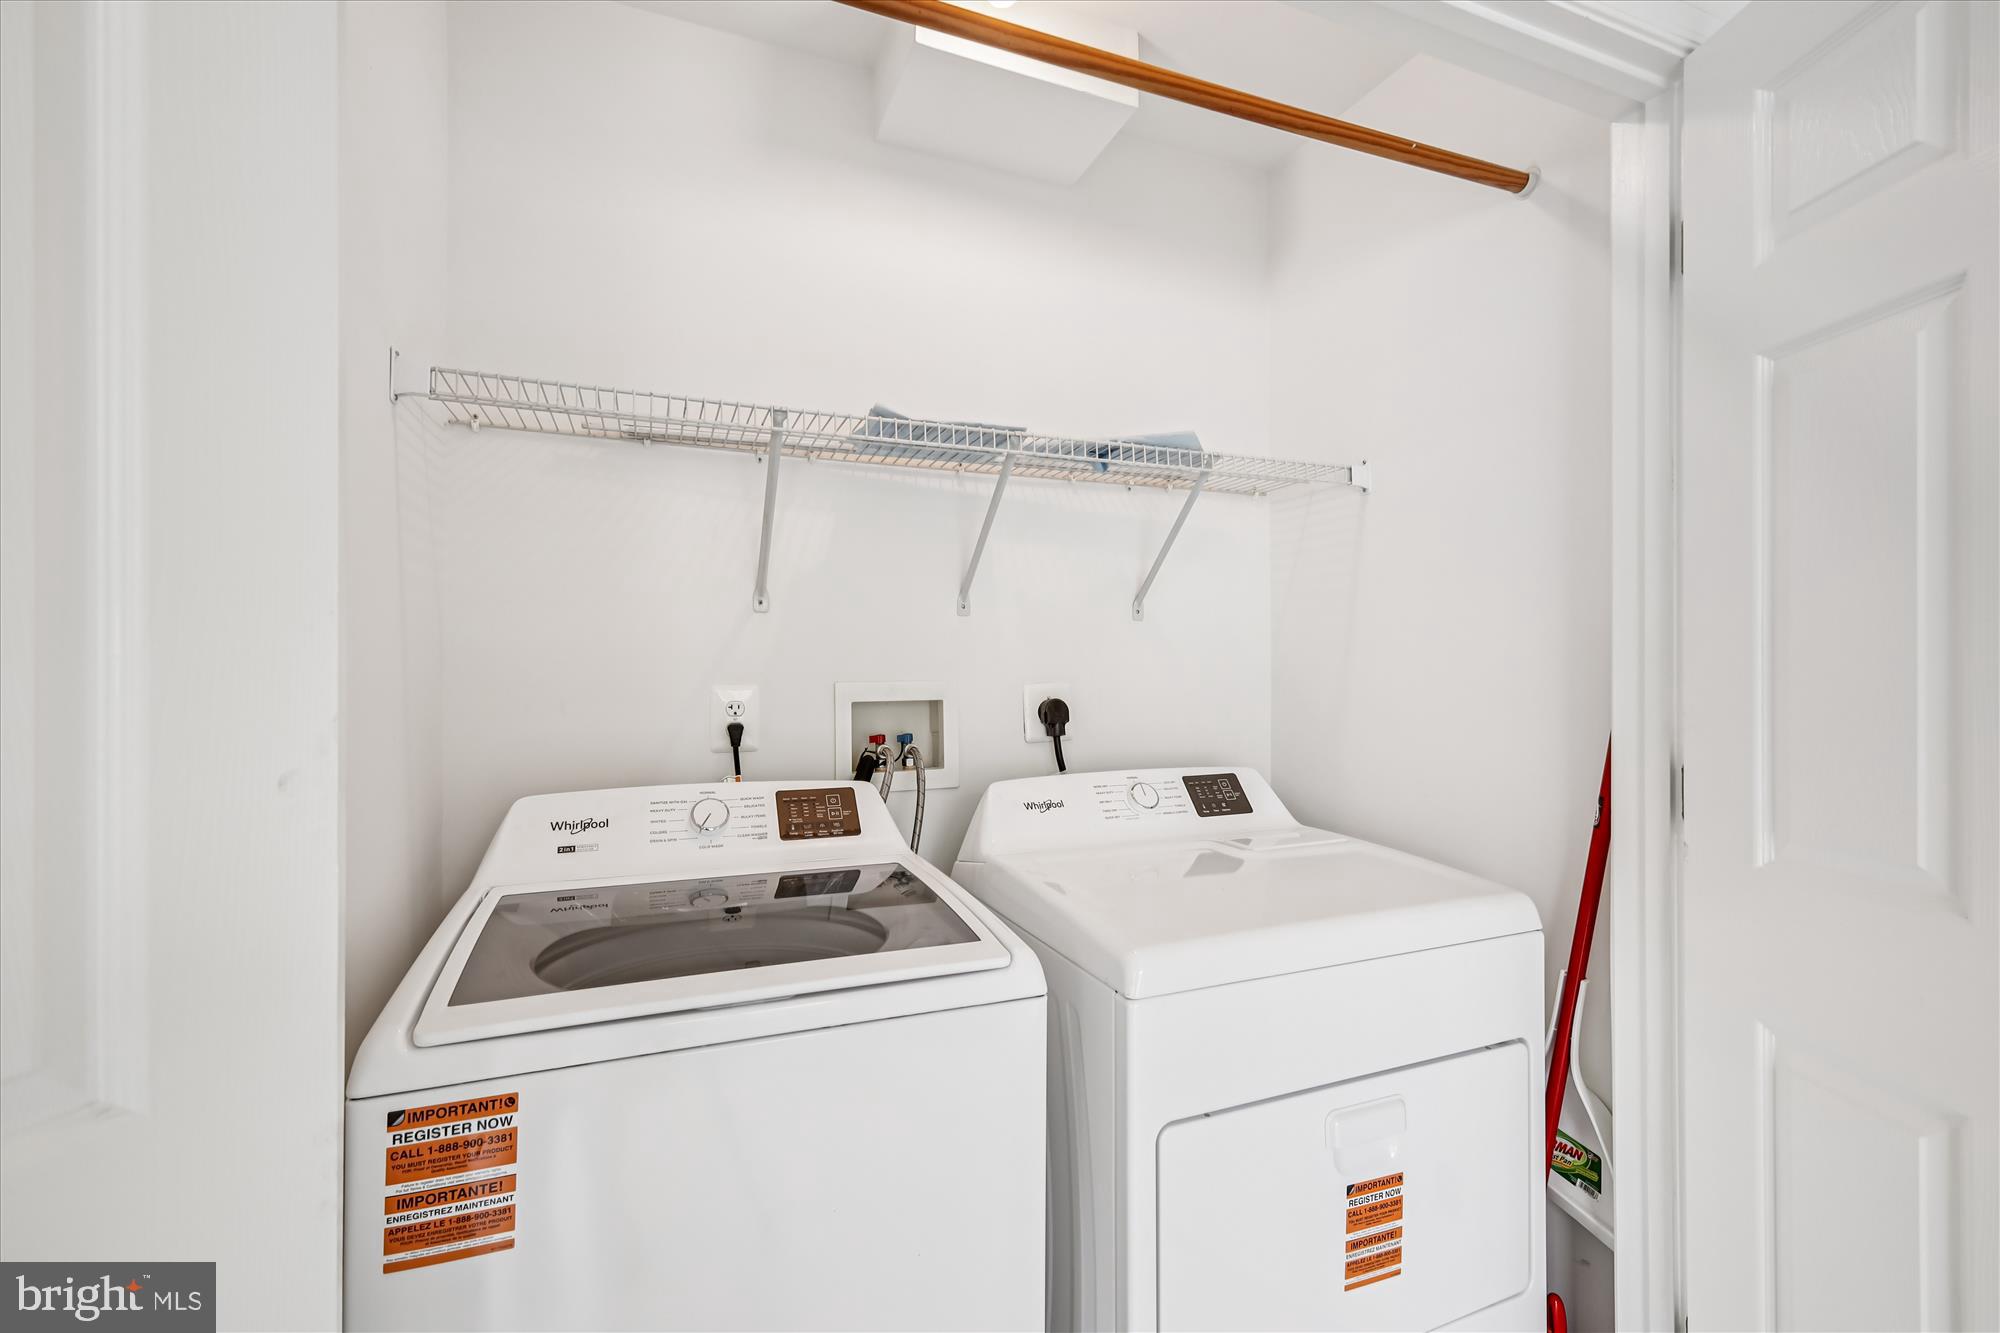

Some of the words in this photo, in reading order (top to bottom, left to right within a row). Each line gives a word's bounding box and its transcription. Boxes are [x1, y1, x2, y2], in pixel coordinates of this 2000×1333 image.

[1024, 800, 1064, 813] Whirlpool
[550, 818, 608, 835] Whirlpool
[408, 1098, 503, 1123] IMPORTANT!
[392, 1122, 472, 1145] REGISTER
[477, 1115, 514, 1131] NOW
[390, 1148, 424, 1161] CALL
[428, 1133, 513, 1155] 1-888-900-3381
[391, 1163, 406, 1171] YOU
[407, 1160, 426, 1168] MUST
[428, 1154, 460, 1164] REGISTER
[462, 1150, 480, 1158] YOUR
[482, 1145, 513, 1155] PRODUCT
[1560, 1156, 1572, 1166] Pan
[396, 1181, 503, 1210] IMPORTANTE!
[1349, 1192, 1384, 1207] REGISTER
[1385, 1187, 1402, 1198] NOW
[386, 1206, 453, 1224] ENREGISTREZ
[455, 1194, 514, 1212] MAINTENANT
[1348, 1209, 1363, 1218] CALL
[388, 1223, 431, 1237] APPELEZ
[434, 1220, 446, 1228] LE
[449, 1207, 512, 1224] 1-888-900-3381
[468, 1220, 487, 1229] VOTRE
[488, 1215, 513, 1224] PRODUIT
[1350, 1230, 1397, 1250] IMPORTANTE!
